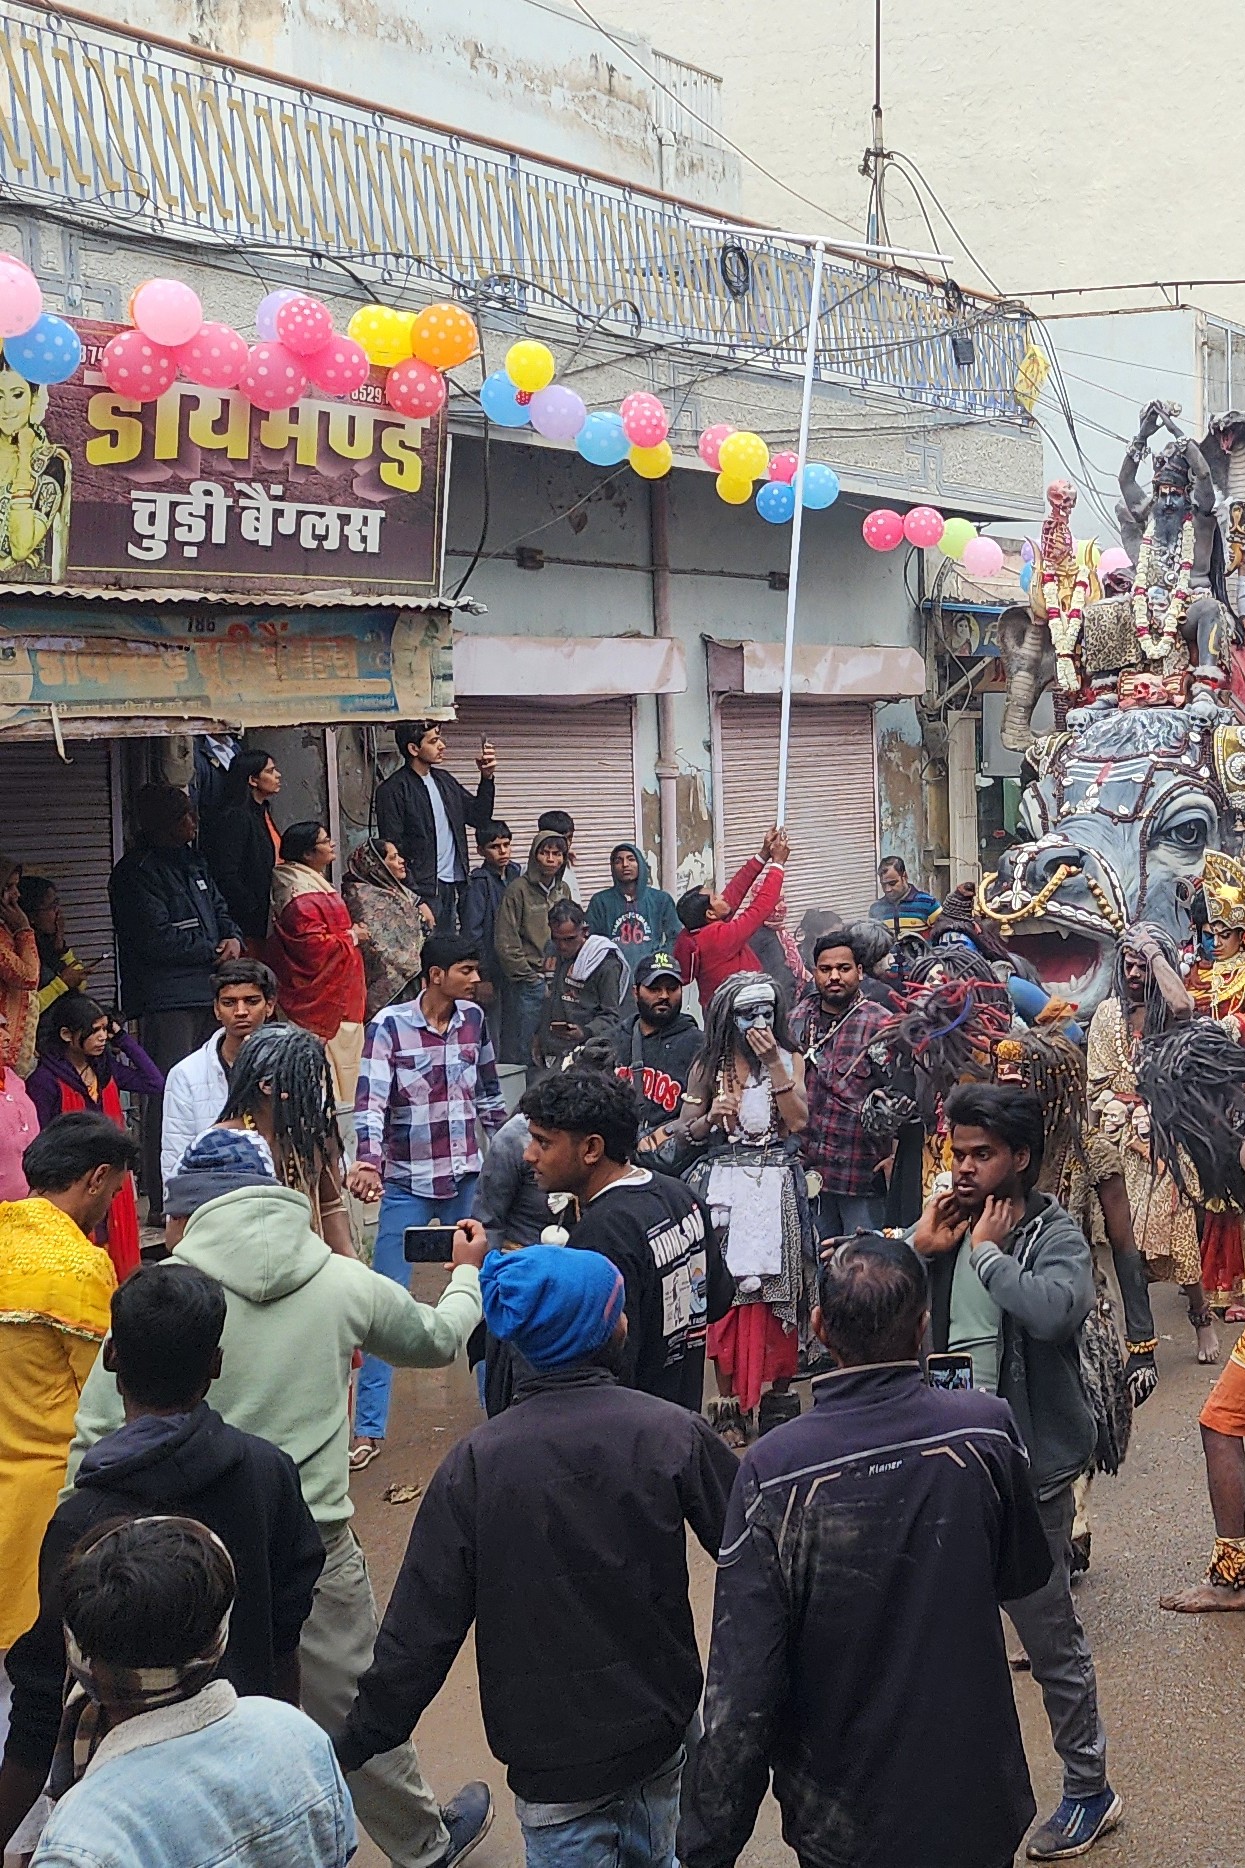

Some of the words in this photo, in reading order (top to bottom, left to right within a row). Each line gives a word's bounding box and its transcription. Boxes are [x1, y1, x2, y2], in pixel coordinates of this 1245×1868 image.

[85, 381, 431, 493] डायमण्ड
[234, 482, 386, 554] बैंग्लस
[620, 921, 644, 945] 86
